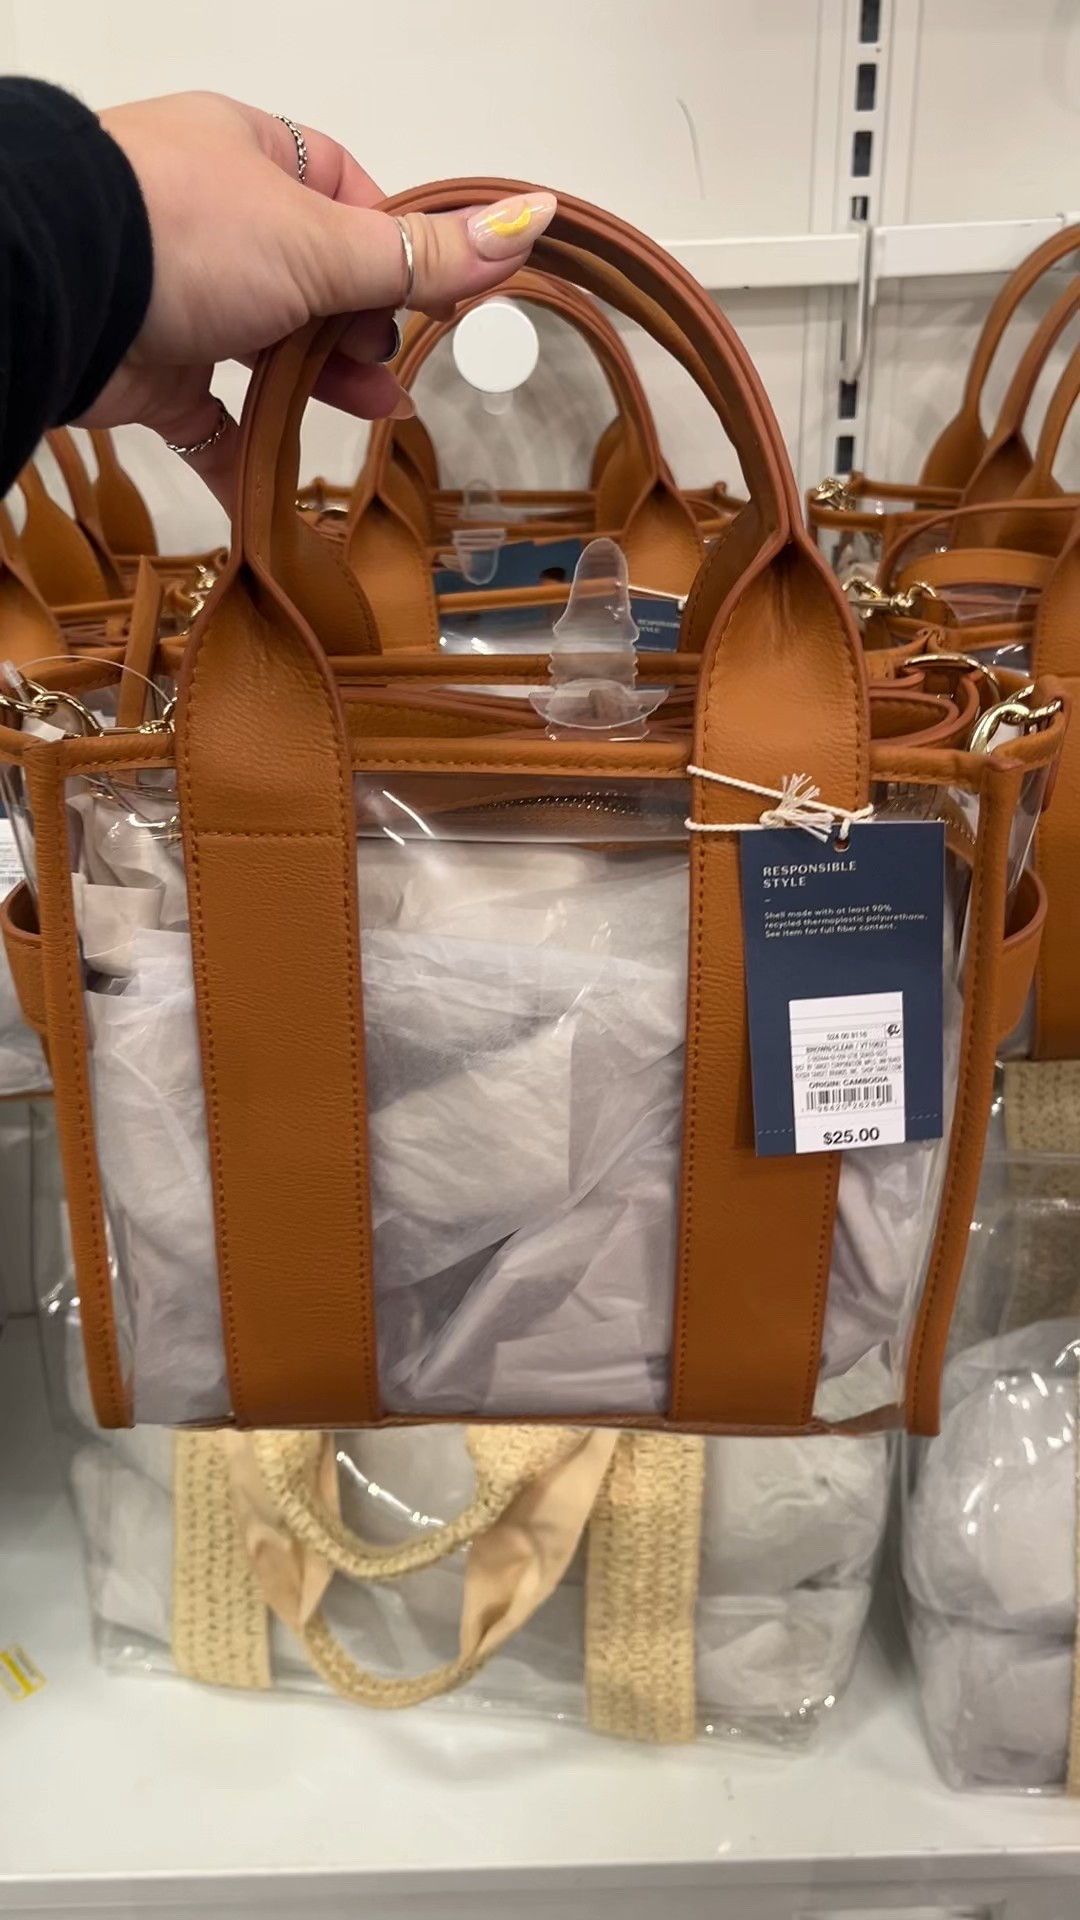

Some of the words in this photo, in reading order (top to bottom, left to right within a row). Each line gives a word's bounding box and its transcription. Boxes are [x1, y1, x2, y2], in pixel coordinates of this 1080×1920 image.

[762, 860, 857, 877] RESPONSIBLE
[762, 876, 807, 889] STYLE
[764, 911, 786, 920] Shell
[787, 908, 812, 918] made
[814, 907, 835, 916] with
[836, 906, 847, 915] at
[848, 904, 870, 914] least
[871, 903, 892, 913] 90%
[764, 919, 802, 931] recycled
[803, 915, 865, 929] thermoplastic
[866, 912, 928, 925] polyurethane.
[765, 929, 781, 939] See
[782, 927, 803, 937] item
[805, 925, 818, 936] for
[819, 924, 835, 935] full
[837, 922, 857, 934] fiber
[859, 922, 897, 933] content.
[843, 1076, 889, 1087] CAMBODIA
[823, 1127, 880, 1145] $25.00
